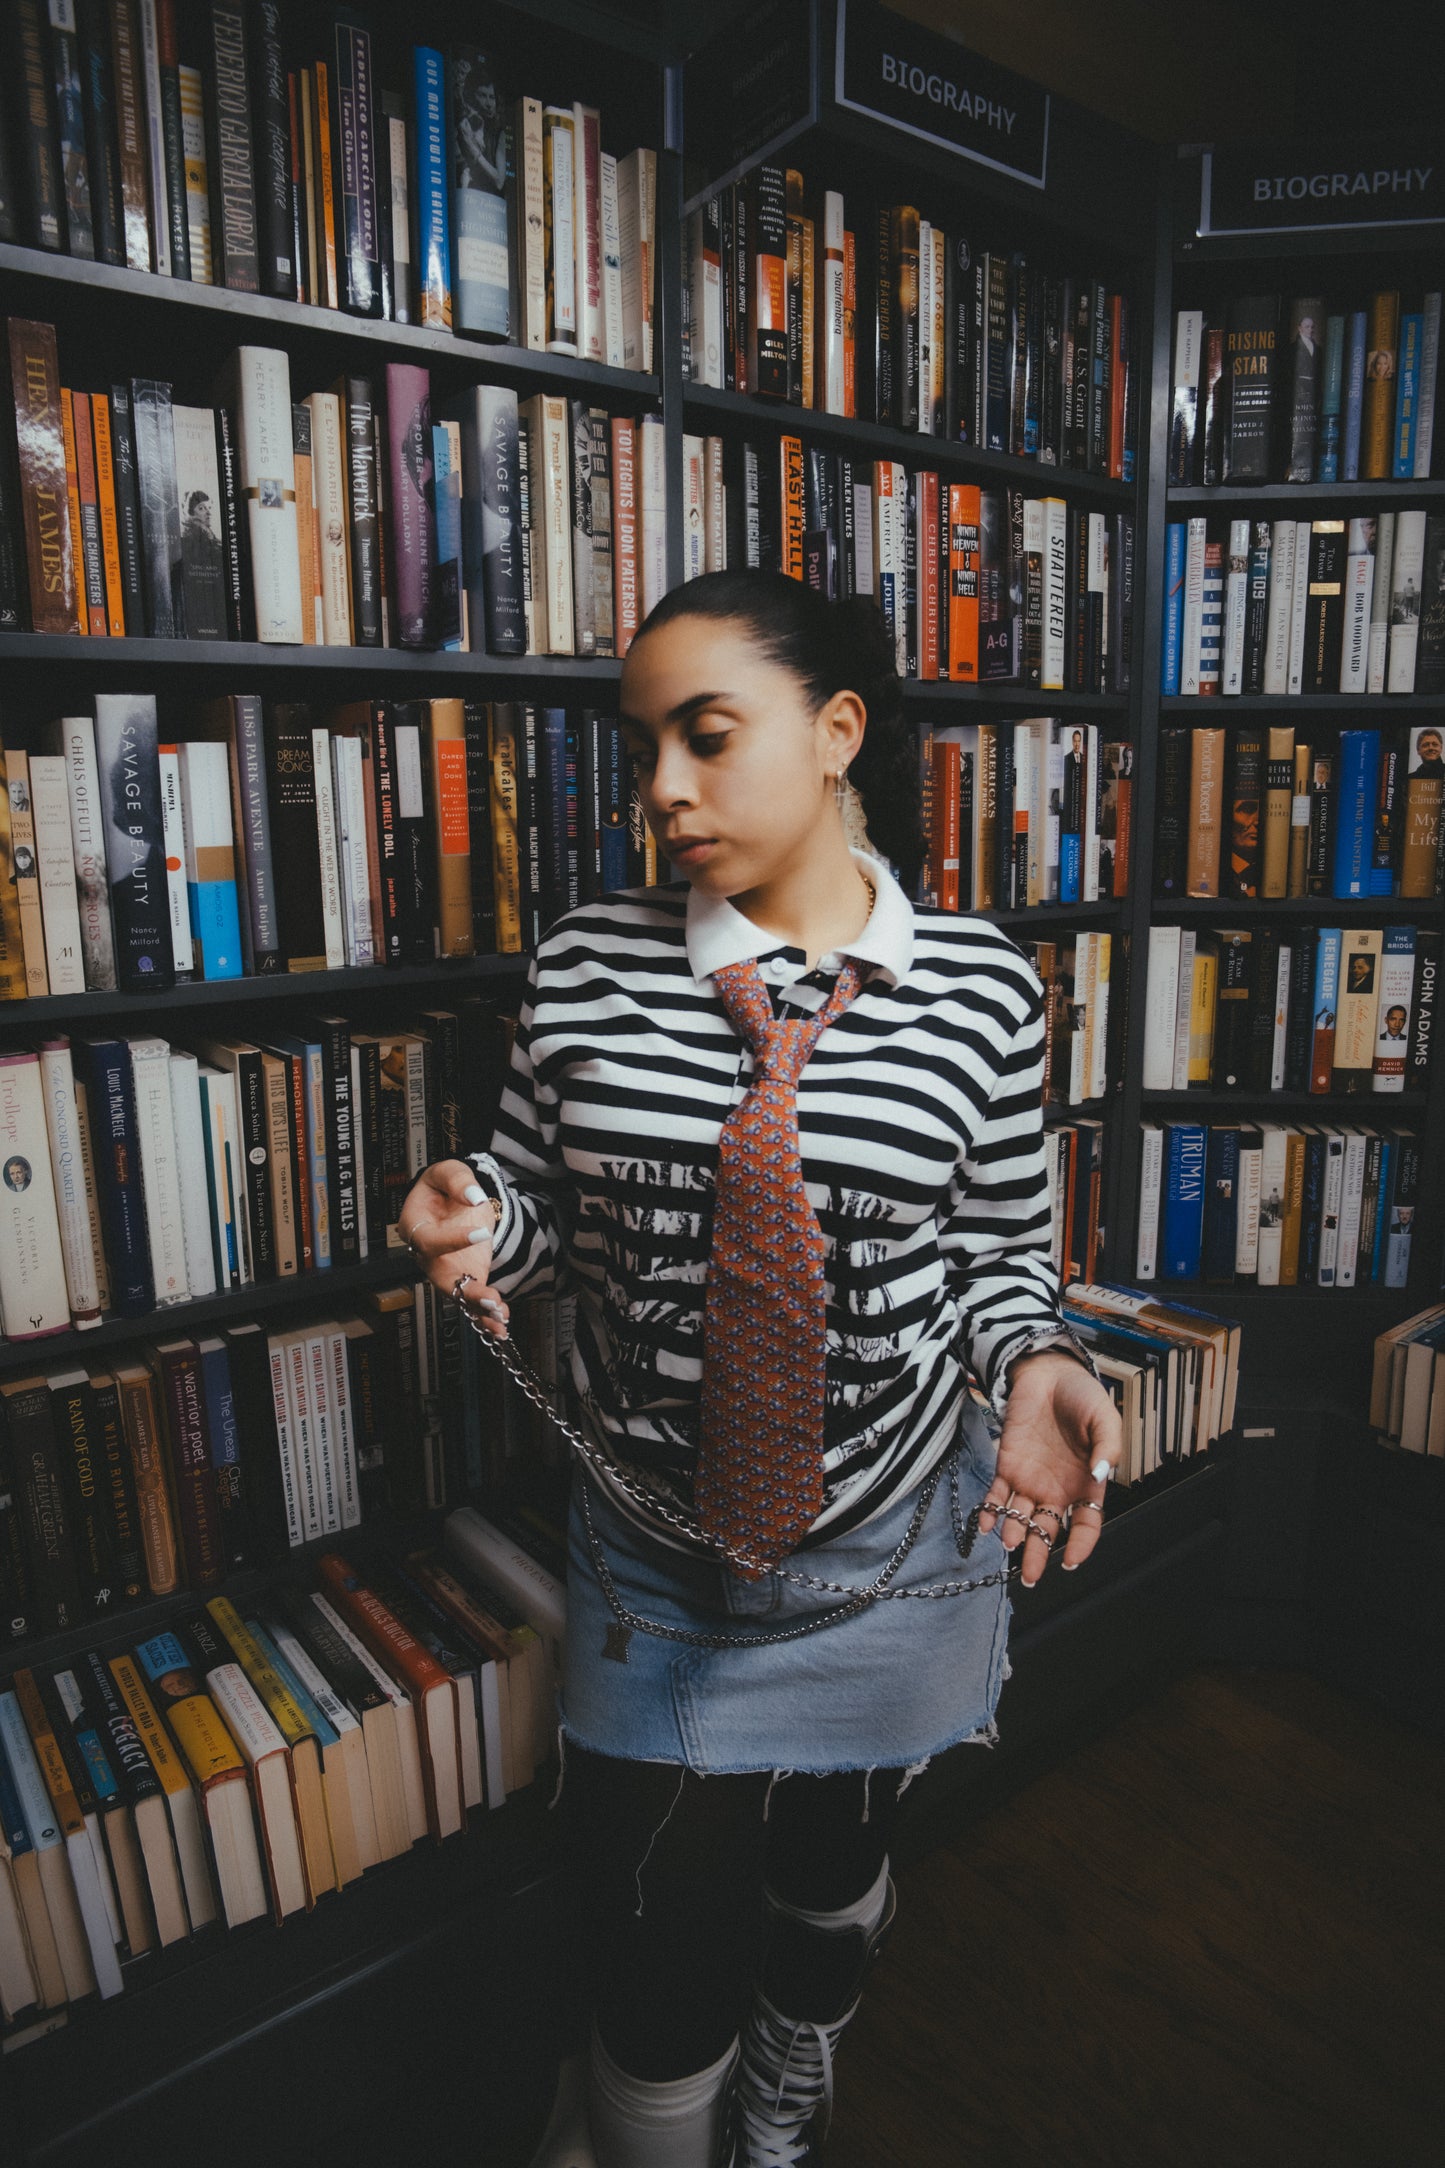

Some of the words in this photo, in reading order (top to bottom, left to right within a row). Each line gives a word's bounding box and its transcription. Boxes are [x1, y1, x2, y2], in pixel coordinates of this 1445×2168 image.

[213, 9, 248, 113] FEDERICO
[356, 39, 368, 123] FEDERICO
[426, 59, 438, 85] OUR
[428, 92, 440, 120] MAN
[882, 53, 1017, 135] BIOGRAPHY
[217, 118, 252, 190] GARCIA
[359, 129, 374, 190] GARCÍA
[429, 125, 441, 162] DOWN
[430, 170, 442, 184] IN
[1253, 168, 1433, 201] BIOGRAPHY
[223, 193, 256, 258] LORCA
[363, 199, 373, 250] LORCA
[430, 190, 443, 242] HAVANA
[792, 222, 800, 288] UNBROKEN
[934, 242, 944, 298] LUCKY
[834, 270, 844, 335] Stauffenberg
[909, 255, 918, 318] UNBROKEN
[1096, 286, 1106, 320] Killing
[935, 302, 944, 332] 666
[1077, 347, 1087, 363] U.
[1096, 322, 1104, 355] Patton
[1228, 331, 1276, 352] RISING
[1066, 341, 1074, 382] ANTHONY
[1077, 366, 1088, 380] S.
[1232, 354, 1270, 377] STAR
[1348, 346, 1363, 398] Covering
[350, 402, 373, 436] The
[1065, 382, 1073, 428] SWOFFORD
[1076, 384, 1088, 429] Grant
[494, 416, 510, 493] SAVAGE
[619, 428, 632, 456] TOY
[352, 444, 374, 523] Maverick
[400, 452, 410, 492] HILARY
[619, 458, 634, 508] FIGHTS
[746, 452, 759, 504] AMERICAN
[789, 450, 801, 510] LAST
[844, 462, 852, 504] STOLEN
[84, 506, 98, 538] MINOR
[402, 496, 412, 554] HOLLADAY
[1014, 492, 1023, 526] CRAZY
[36, 482, 64, 593] JAMES
[104, 506, 116, 555] Missing
[498, 505, 512, 578] BEAUTY
[620, 525, 634, 554] DON
[746, 507, 760, 568] MERCENARY
[790, 515, 802, 574] HILL
[928, 524, 936, 576] CHRIS
[952, 540, 978, 552] HEAVEN
[1125, 524, 1133, 553] JOE
[109, 560, 119, 584] Men
[362, 538, 372, 568] Thomas
[1188, 539, 1202, 606] NAZARBAYEV
[1254, 551, 1267, 569] PT
[1276, 536, 1286, 584] MATTERS
[1285, 528, 1295, 590] CHARACTER
[1326, 548, 1336, 572] TEAM
[1355, 560, 1368, 586] RAGE
[88, 542, 102, 605] CHARACTERS
[362, 570, 374, 602] Harding
[954, 584, 974, 596] HELL
[955, 570, 976, 583] NINTH
[1050, 536, 1065, 639] SHATTERED
[1124, 557, 1132, 603] BIDEN
[1252, 575, 1267, 599] 109
[622, 560, 636, 629] PATERSON
[1354, 592, 1366, 614] BOB
[928, 583, 937, 664] CHRISTIE
[1168, 602, 1177, 646] THANKS,
[1276, 608, 1286, 631] JEAN
[986, 632, 1008, 649] A-G
[1275, 634, 1285, 670] BECKER
[1350, 616, 1365, 672] WOODWARD
[1166, 648, 1175, 682] OBAMA
[242, 708, 257, 738] 1185
[70, 736, 85, 781] CHRIS
[120, 726, 142, 810] SAVAGE
[246, 743, 259, 783] PARK
[276, 750, 310, 760] DREAM
[276, 762, 313, 773] SONG
[610, 730, 620, 769] MARION
[1200, 734, 1216, 779] Theodore
[1388, 752, 1398, 785] GEORGE
[166, 772, 176, 811] MISHIMA
[500, 736, 513, 811] crabcakes
[610, 772, 620, 806] MEADE
[988, 734, 996, 818] AMERICA'S
[1356, 775, 1364, 790] THE
[76, 786, 92, 846] OFFUTT
[1199, 781, 1215, 825] Roosevelt
[1354, 792, 1366, 822] PRIME
[1386, 786, 1396, 811] BUSH
[249, 790, 264, 852] AVENUE
[1409, 832, 1440, 846] Life
[1414, 813, 1440, 827] My
[528, 826, 538, 858] MALACHY
[1352, 826, 1365, 879] MINISTERS
[82, 856, 96, 878] NO
[128, 826, 150, 906] BEAUTY
[255, 868, 268, 899] Anne
[530, 860, 540, 894] McCOURT
[86, 884, 102, 942] HEROES
[258, 904, 270, 946] Roiphe
[1322, 938, 1337, 1000] RENEGADE
[1420, 958, 1437, 1003] JOHN
[1414, 1008, 1432, 1066] ADAMS
[408, 1052, 423, 1075] THIS
[248, 1072, 260, 1110] Rebecca
[269, 1072, 286, 1098] THIS
[335, 1075, 349, 1101] THE
[410, 1078, 424, 1102] BOY'S
[0, 1074, 20, 1143] Trollope
[251, 1113, 262, 1142] Solnit
[271, 1102, 287, 1132] BOY'S
[336, 1106, 351, 1150] YOUNG
[411, 1105, 424, 1128] LIFE
[274, 1134, 289, 1154] LIFE
[1294, 1144, 1305, 1162] BILL
[255, 1171, 266, 1188] The
[1180, 1132, 1206, 1202] TRUMAN
[1248, 1154, 1261, 1200] HIDDEN
[1292, 1164, 1304, 1208] CLINTON
[255, 1192, 268, 1227] Faraway
[340, 1188, 356, 1231] WELLS
[1246, 1206, 1258, 1248] POWER
[12, 1207, 29, 1285] GLENDINNING
[258, 1230, 270, 1262] Nearby
[67, 1398, 86, 1434] RAIN
[184, 1372, 201, 1428] warrior
[218, 1391, 232, 1418] The
[73, 1437, 88, 1456] OF
[104, 1422, 119, 1462] WILD
[186, 1432, 206, 1462] poet
[220, 1422, 238, 1463] Uneasy
[76, 1458, 95, 1498] GOLD
[227, 1466, 241, 1498] Chair
[110, 1468, 132, 1538] ROMANCE
[144, 1642, 164, 1669] SACKS
[190, 1622, 218, 1655] STARZL
[118, 1666, 136, 1688] HIDDEN
[127, 1689, 145, 1710] VALLEY
[136, 1710, 154, 1730] ROAD
[222, 1664, 237, 1680] THE
[232, 1682, 257, 1710] PUZZLE
[248, 1711, 274, 1743] PEOPLE
[107, 1716, 150, 1773] LEGACY
